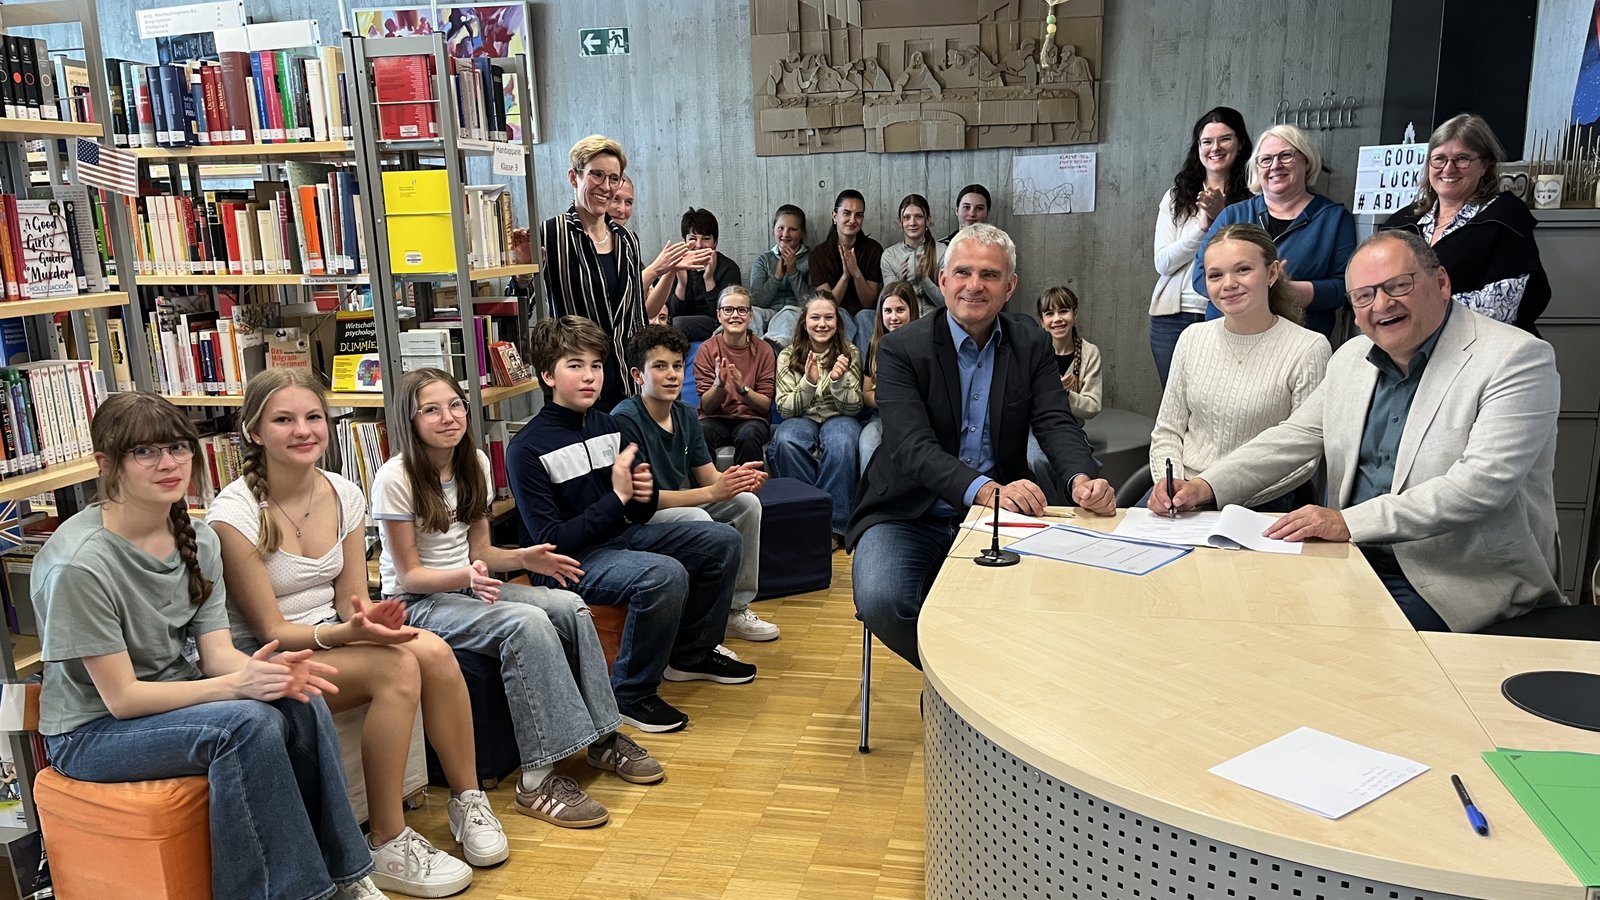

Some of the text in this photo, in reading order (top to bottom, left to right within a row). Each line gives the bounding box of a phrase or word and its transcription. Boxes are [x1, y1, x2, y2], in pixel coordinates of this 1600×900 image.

[1385, 149, 1425, 166] GOOD
[501, 162, 518, 172] Klasse 9
[1380, 170, 1419, 188] LUCK
[25, 216, 57, 233] A Good
[26, 233, 54, 252] Girl's
[38, 251, 66, 266] Guide
[31, 265, 70, 282] Murder
[345, 328, 376, 337] psycholog
[340, 340, 378, 352] DUMMIE
